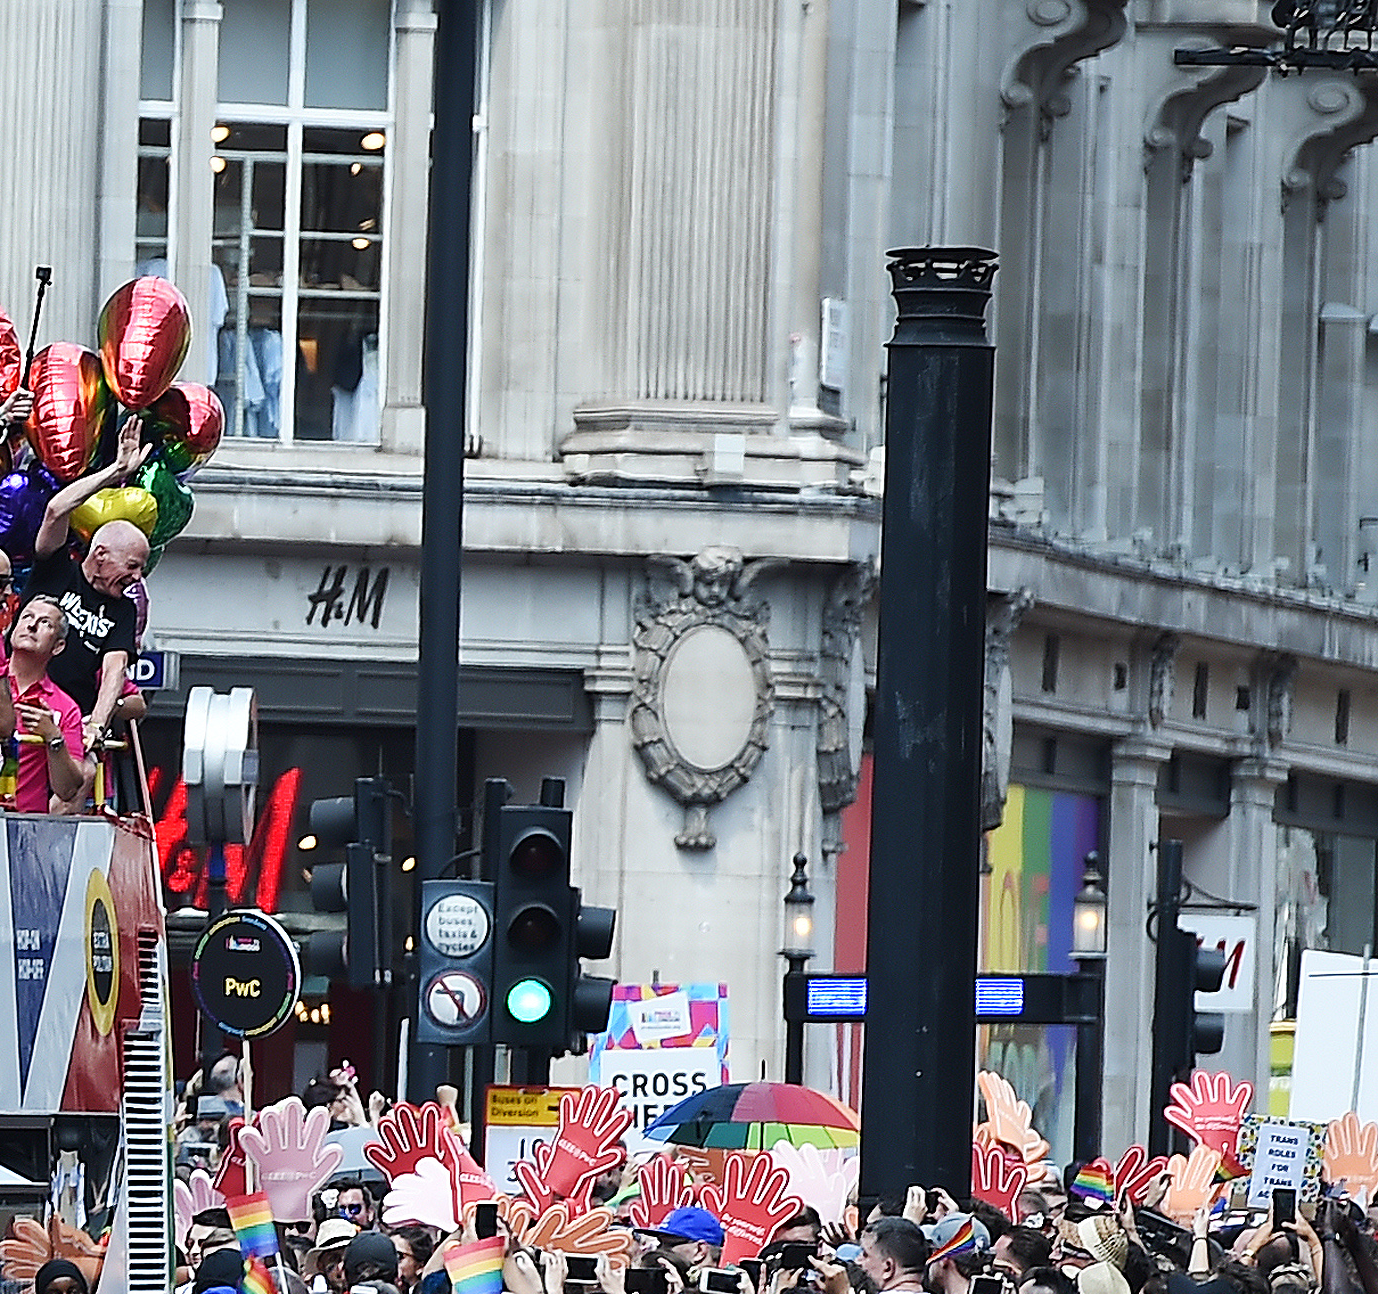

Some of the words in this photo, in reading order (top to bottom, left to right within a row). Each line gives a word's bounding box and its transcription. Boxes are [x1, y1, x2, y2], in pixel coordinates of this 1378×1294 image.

[306, 565, 389, 629] H&M
[438, 903, 478, 914] Except
[438, 929, 468, 938] taxis
[438, 943, 475, 954] cycles
[225, 977, 261, 998] PwC
[612, 1072, 707, 1098] CROSS
[491, 1094, 519, 1105] Buses
[524, 1096, 538, 1105] on
[491, 1107, 539, 1118] Diversion
[1270, 1135, 1298, 1145] TRANS
[1268, 1148, 1296, 1159] ROLES
[1271, 1164, 1289, 1172] FOR
[1263, 1177, 1292, 1187] TRANS
